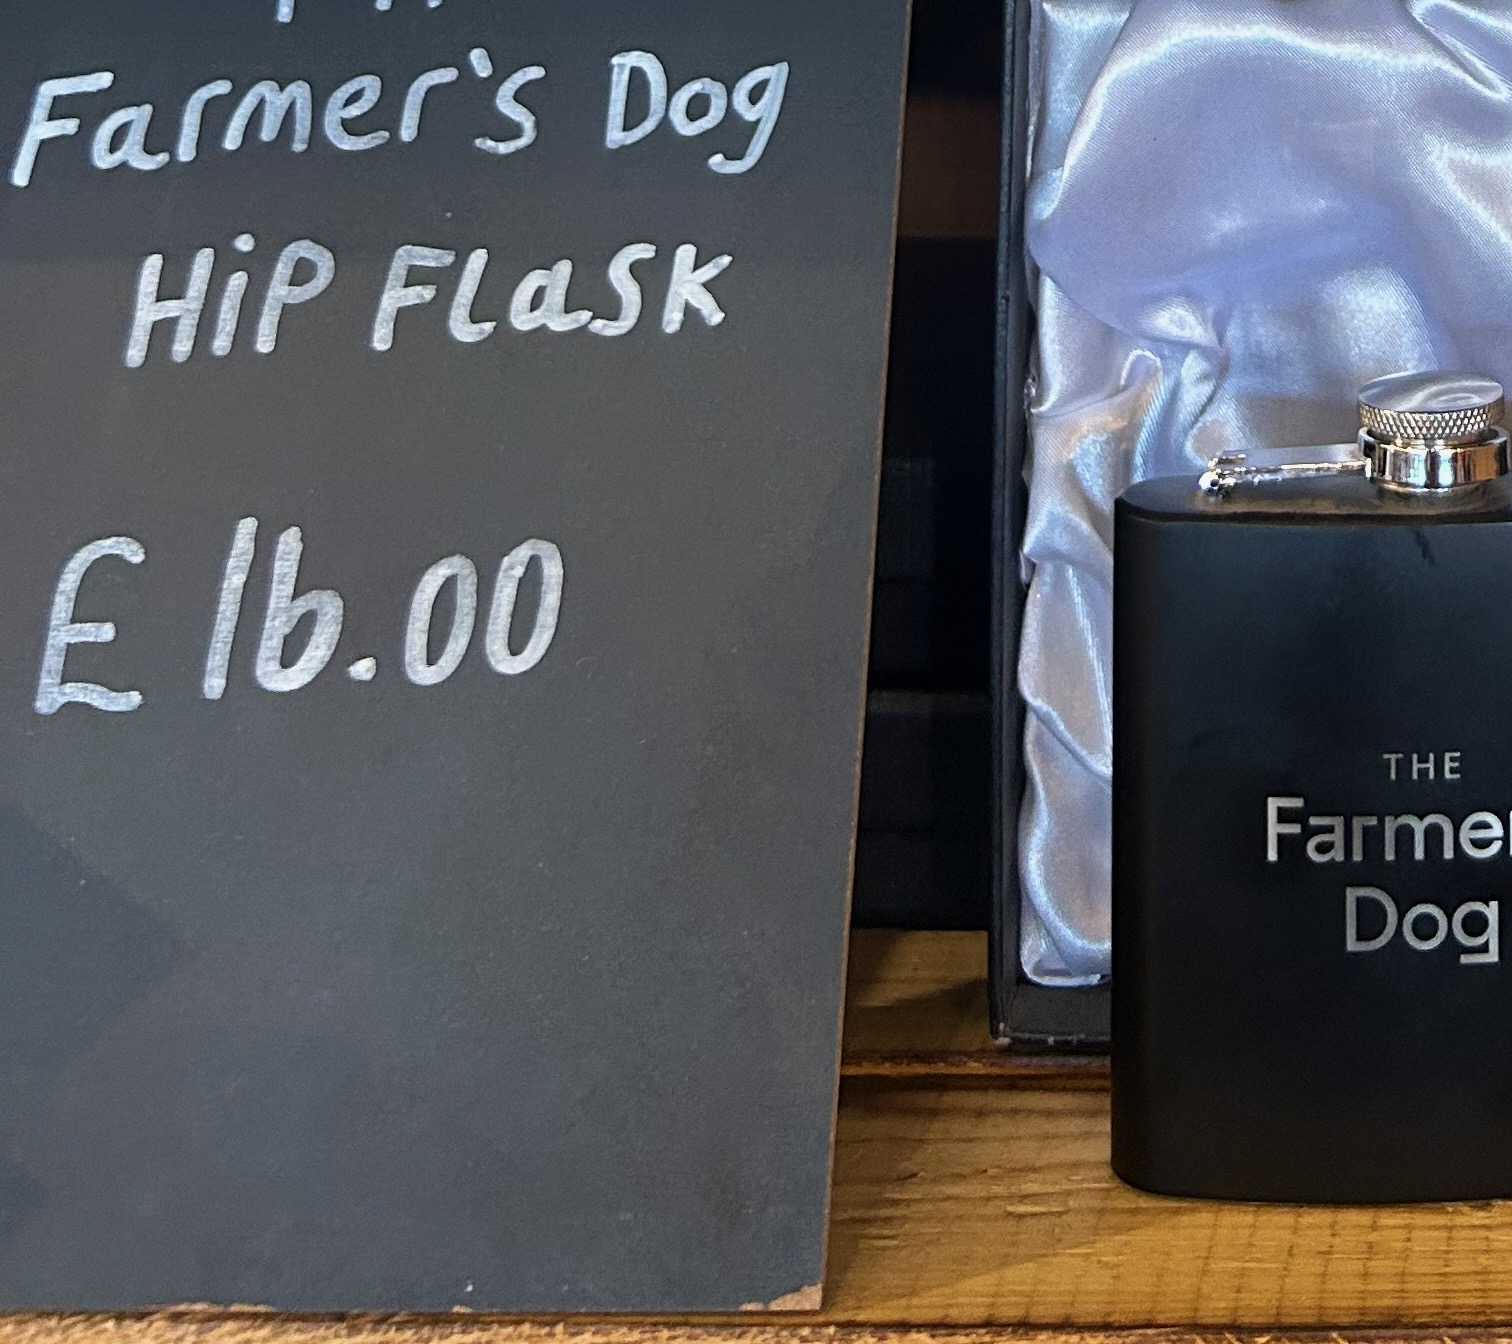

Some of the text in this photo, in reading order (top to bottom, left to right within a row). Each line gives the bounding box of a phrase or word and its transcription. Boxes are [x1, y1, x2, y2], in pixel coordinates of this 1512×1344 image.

[10, 47, 789, 187] Farmer's Dog
[1383, 751, 1461, 781] THE
[1345, 886, 1500, 964] Dog
